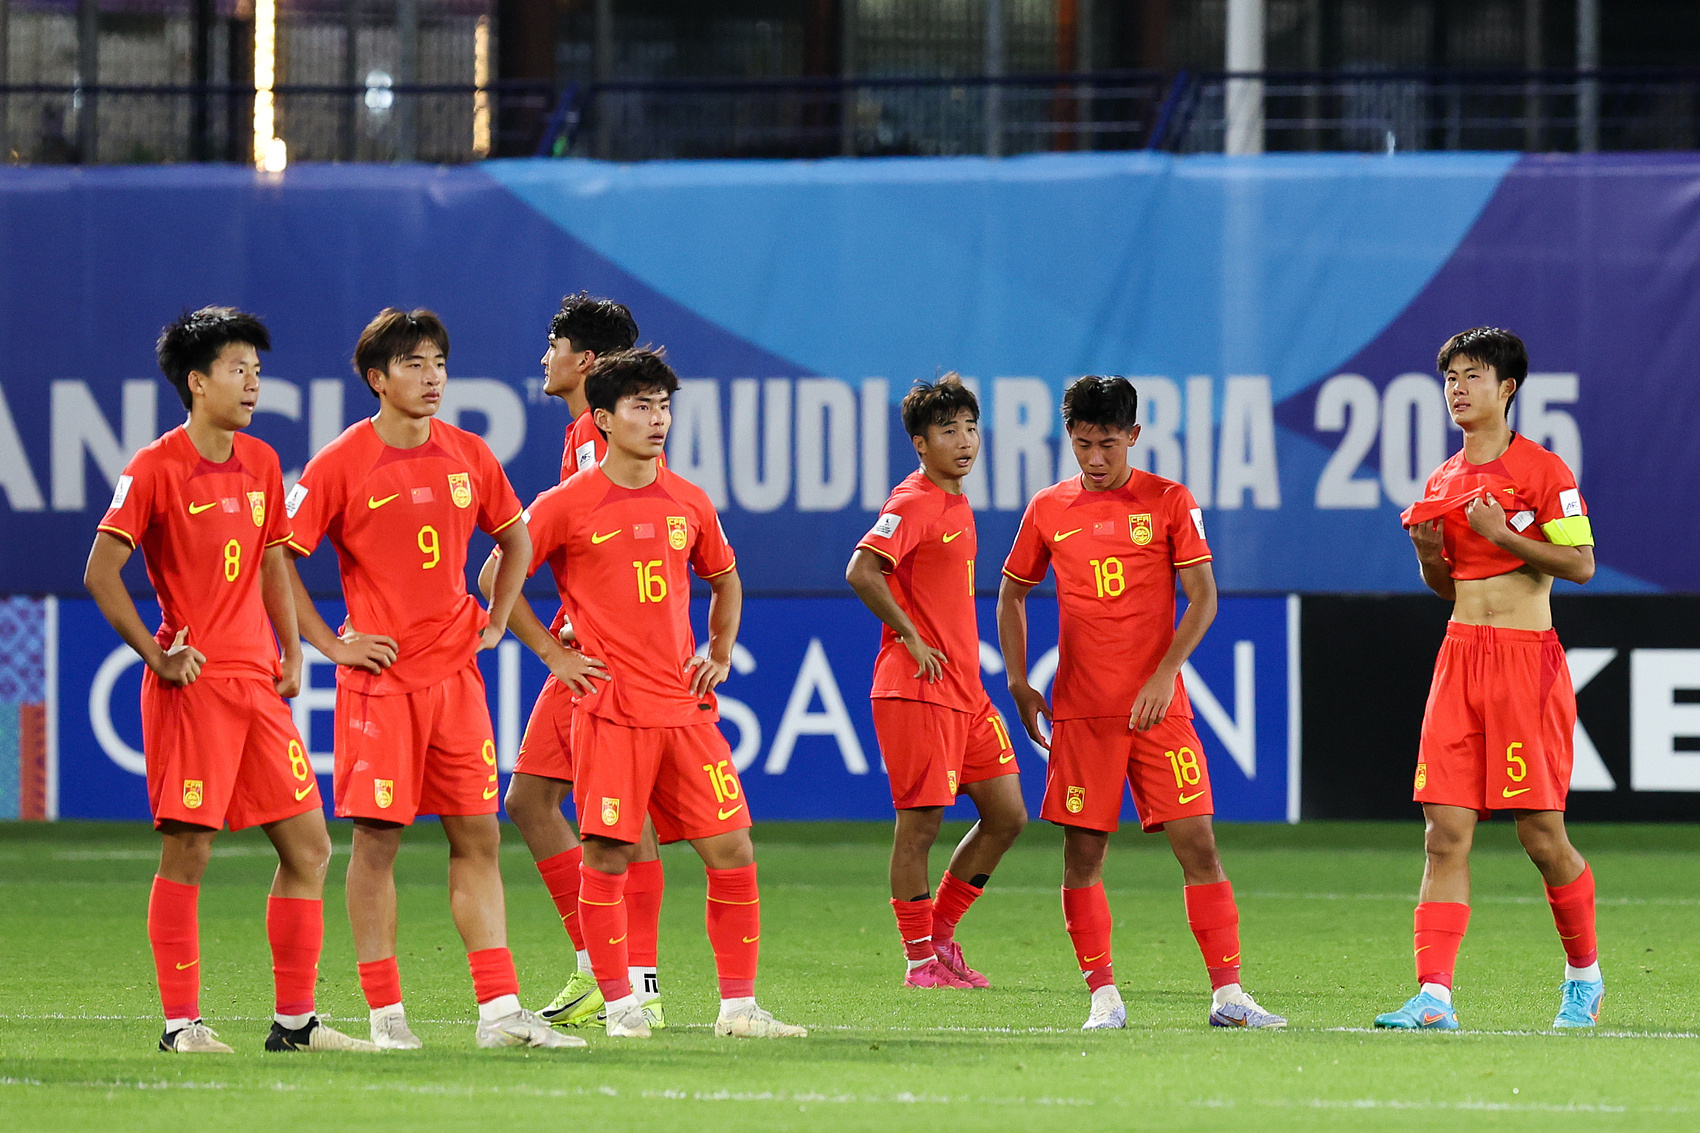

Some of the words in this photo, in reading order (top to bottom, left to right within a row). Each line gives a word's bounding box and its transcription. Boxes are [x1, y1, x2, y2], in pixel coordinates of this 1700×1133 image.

[667, 377, 888, 512] AUDI
[1314, 372, 1582, 509] 205
[224, 539, 242, 582] 8
[417, 525, 441, 569] 9
[632, 560, 668, 603] 16
[1089, 556, 1126, 598] 18
[287, 739, 309, 781] 8
[481, 739, 498, 782] 9
[702, 759, 740, 803] 16
[1164, 746, 1201, 789] 18
[1506, 742, 1527, 782] 5
